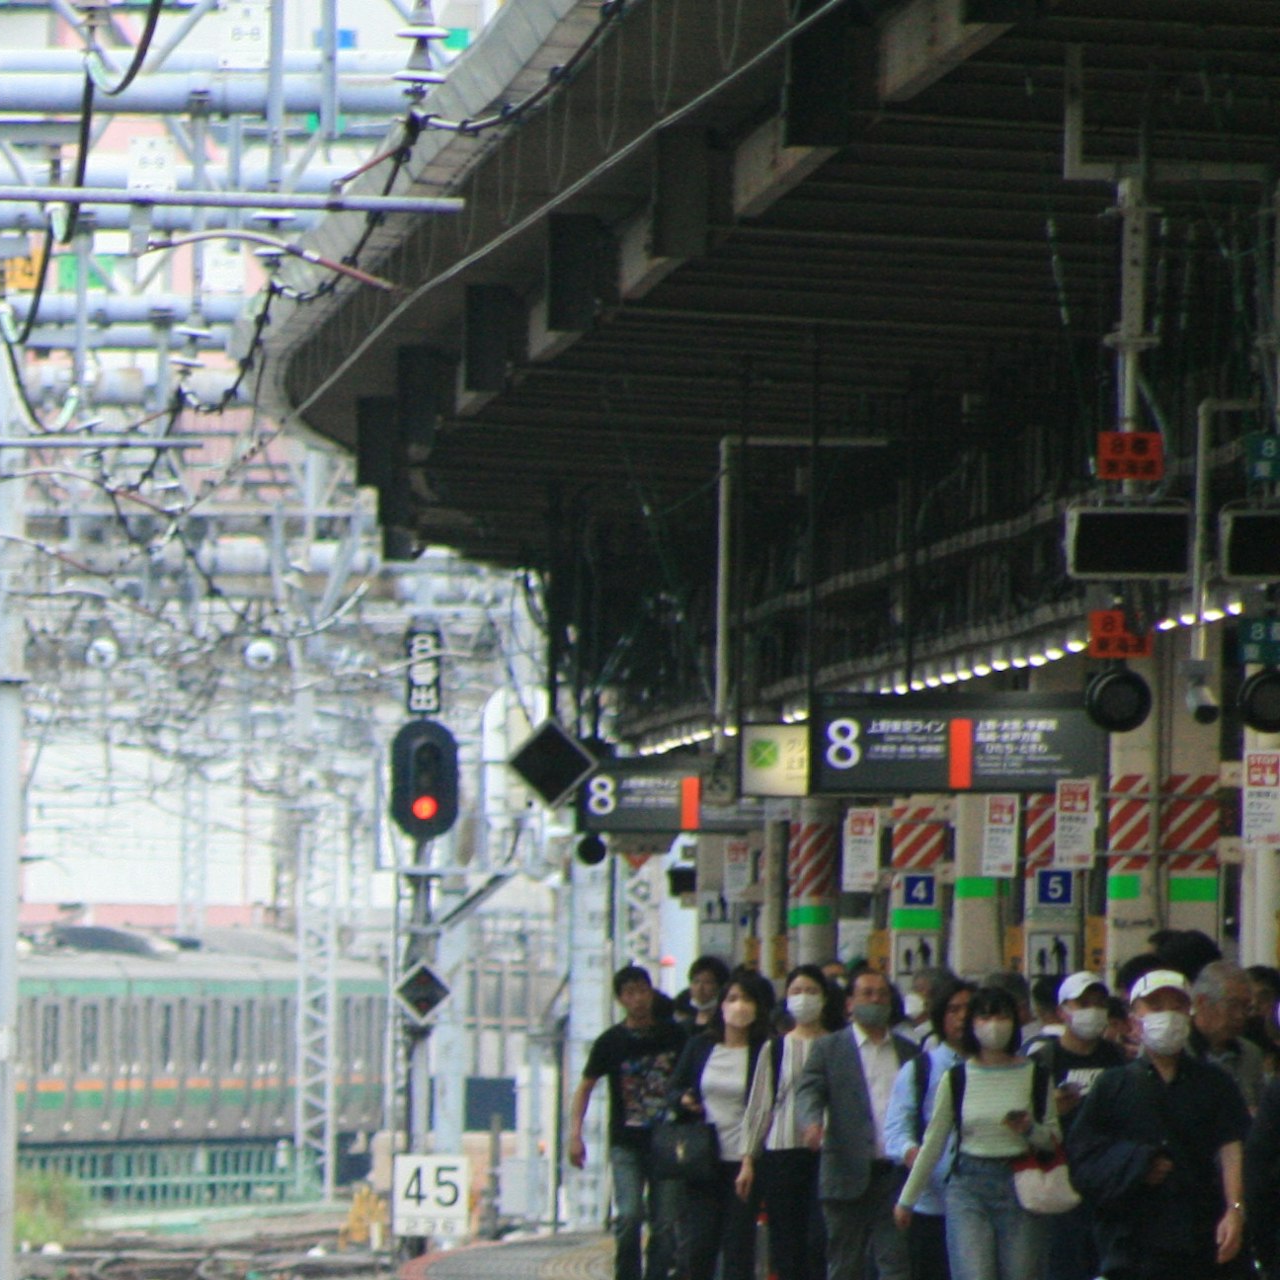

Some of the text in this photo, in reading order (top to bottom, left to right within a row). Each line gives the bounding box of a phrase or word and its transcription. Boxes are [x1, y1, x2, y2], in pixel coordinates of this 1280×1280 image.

[826, 718, 861, 770] 8
[588, 775, 616, 815] 8
[911, 880, 928, 901] 4
[1047, 876, 1064, 898] 5
[404, 1166, 459, 1208] 45
